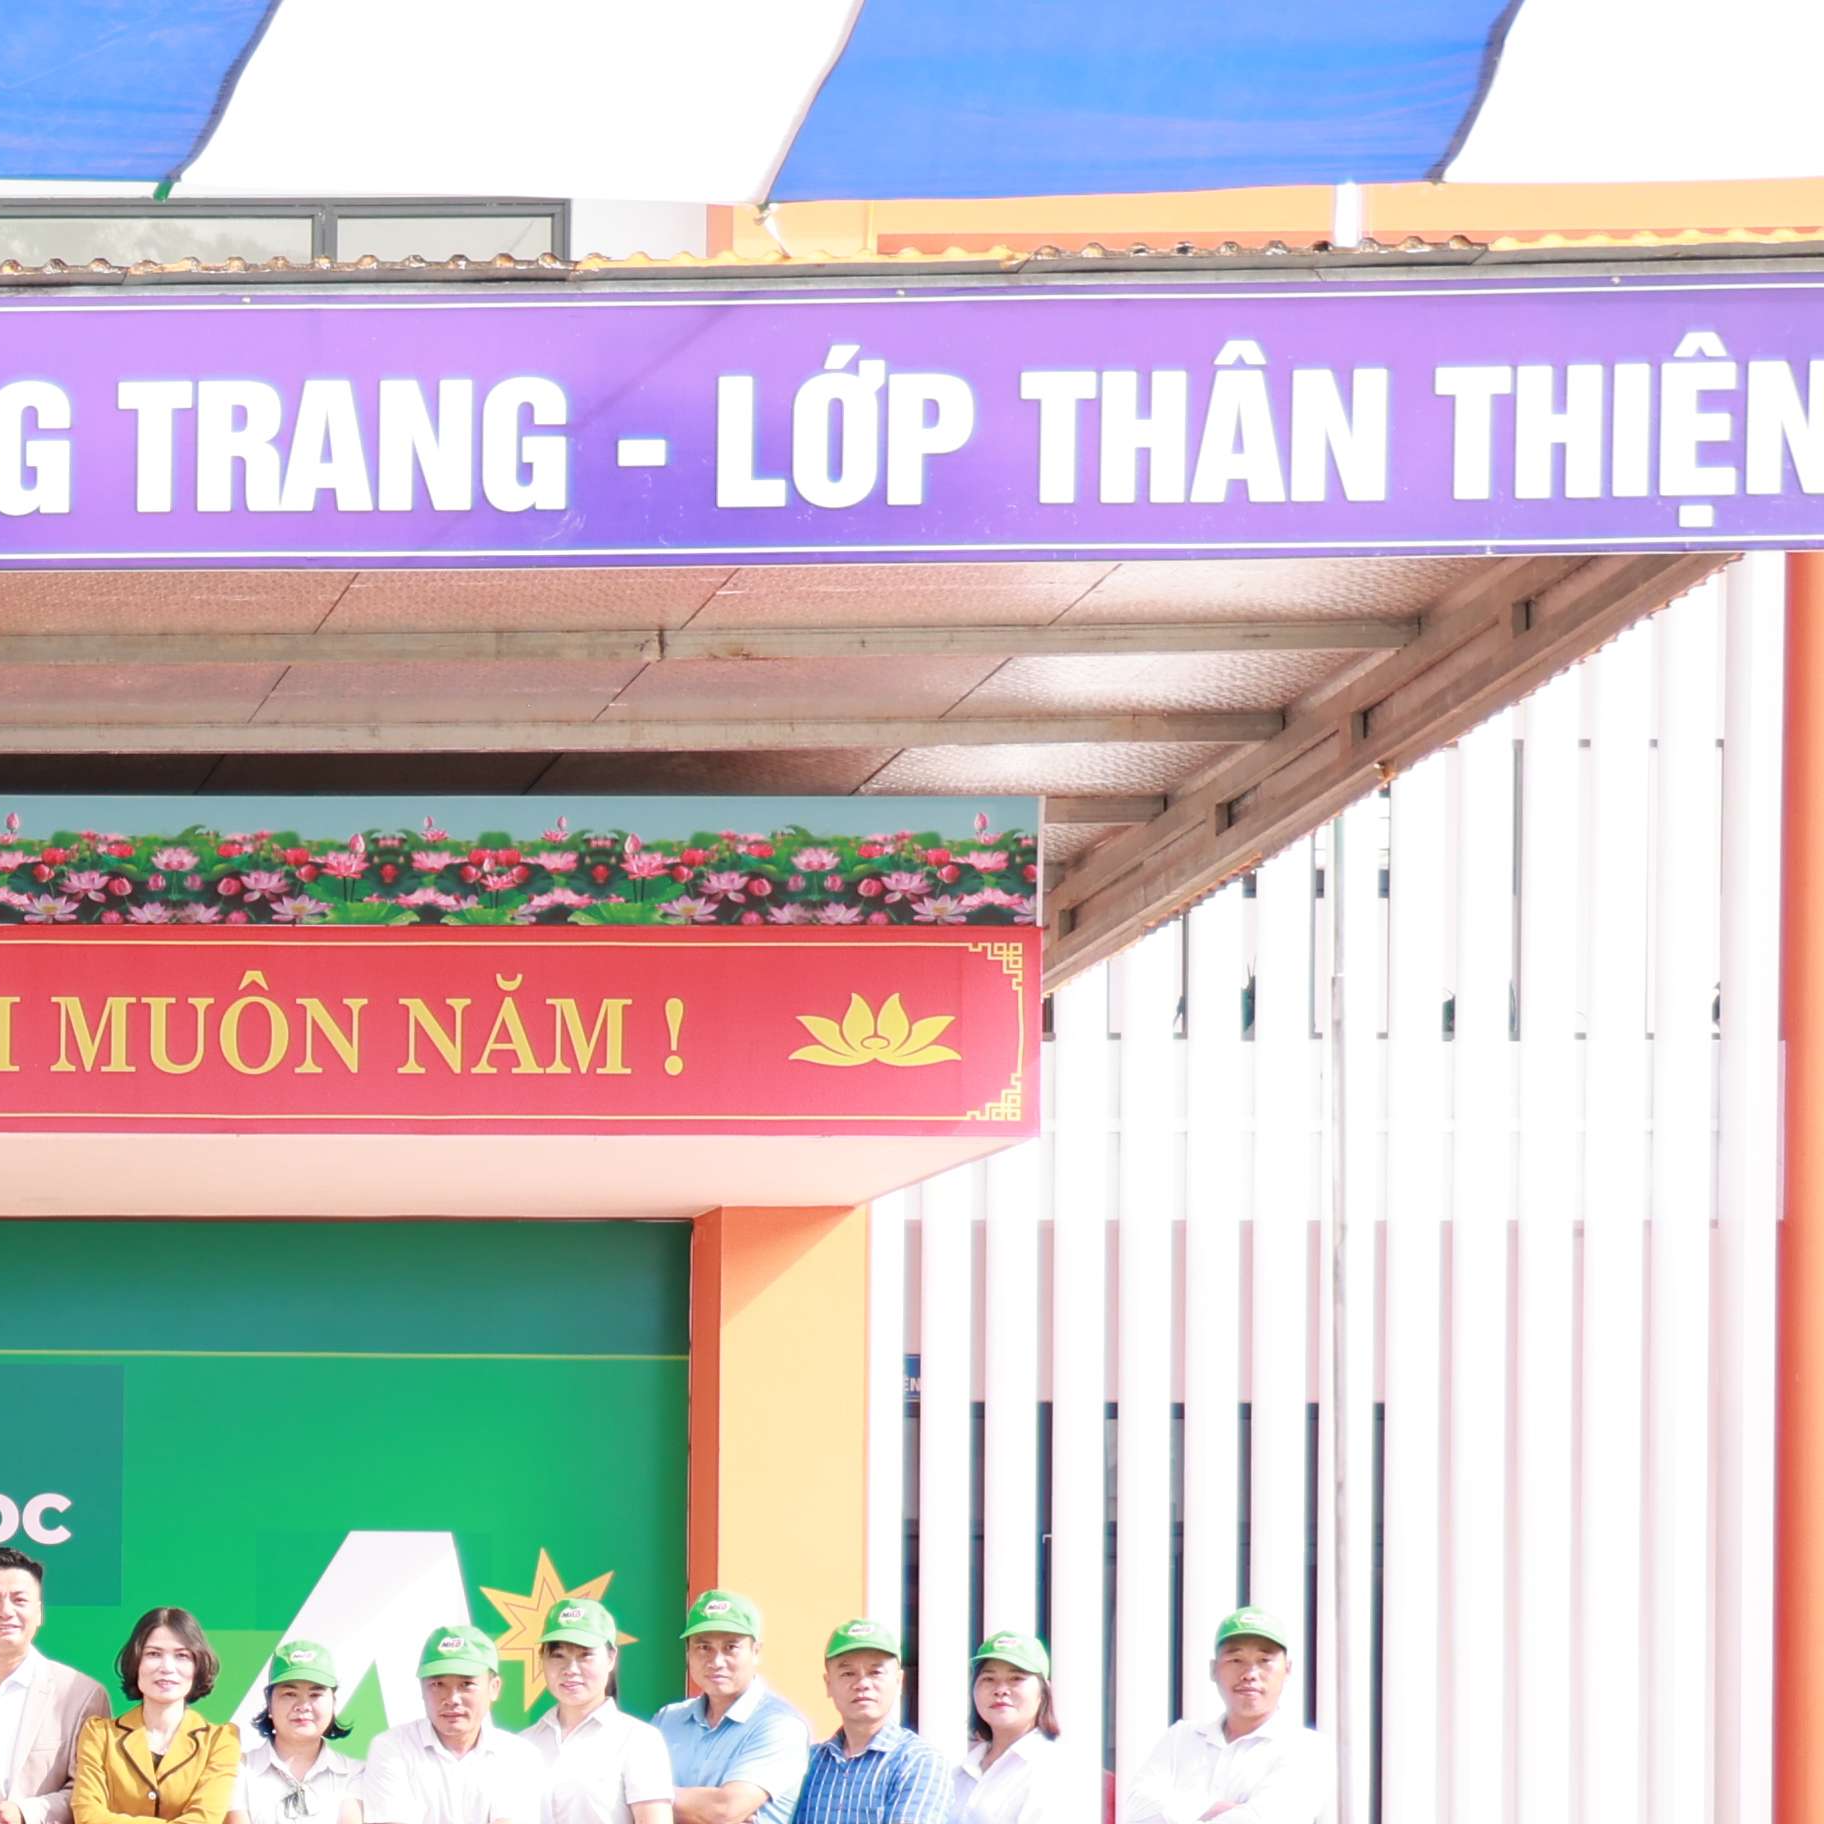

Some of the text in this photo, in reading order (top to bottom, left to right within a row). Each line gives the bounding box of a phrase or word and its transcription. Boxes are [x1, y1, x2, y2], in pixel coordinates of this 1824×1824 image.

[118, 375, 567, 513] TRANG
[618, 439, 667, 467] -
[717, 344, 975, 508] LỚP
[1021, 339, 1389, 504] THÂN
[1435, 331, 1824, 528] THIỆN
[50, 970, 369, 1075] MUÔN
[398, 974, 633, 1075] NĂM
